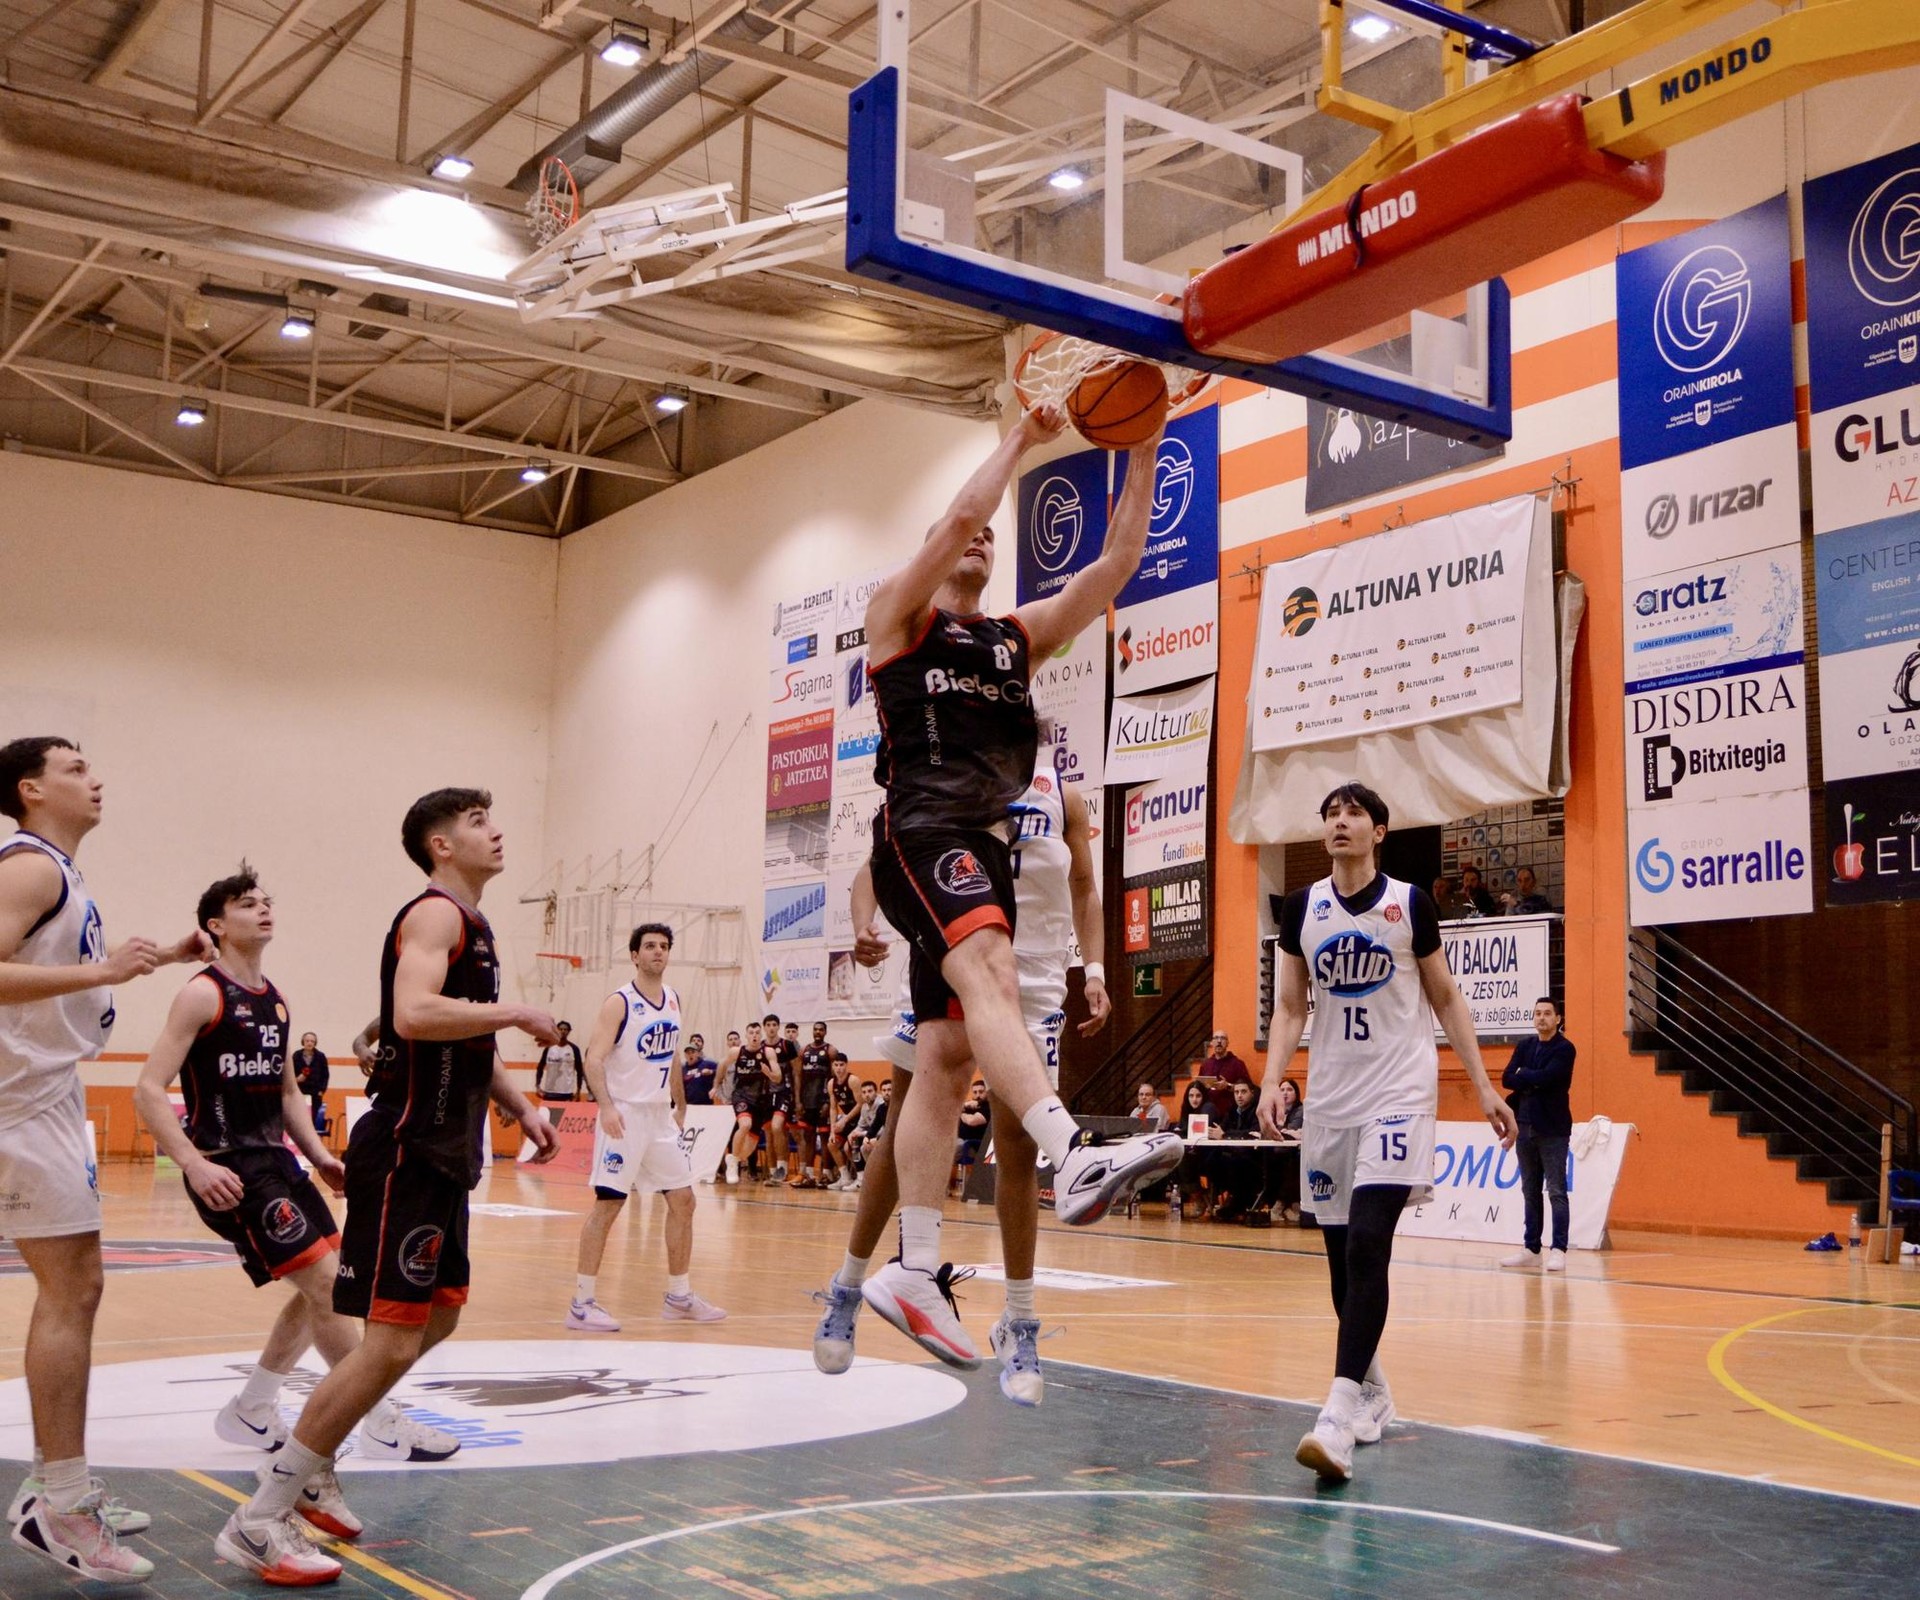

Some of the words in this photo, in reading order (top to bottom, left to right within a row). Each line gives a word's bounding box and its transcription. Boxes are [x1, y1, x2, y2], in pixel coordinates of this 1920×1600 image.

[1660, 36, 1772, 105] MONDO
[1663, 368, 1742, 403] ORAINKIROLA
[1141, 536, 1187, 557] RAINKIROLA
[1327, 572, 1421, 619] ALTUNA
[1427, 565, 1442, 592] Y
[1446, 550, 1504, 588] URIA
[1872, 576, 1910, 591] ENGLISH
[1635, 574, 1727, 616] aratz
[1477, 620, 1496, 631] ALTUNA
[1501, 615, 1516, 624] URIA
[842, 631, 858, 648] 943
[1136, 621, 1214, 663] sidenor
[1407, 637, 1429, 647] ALTUNA
[1433, 632, 1446, 641] URIA
[993, 644, 1012, 671] 8
[1341, 651, 1361, 661] ALTUNA
[1366, 648, 1378, 656] URIA
[1441, 650, 1461, 660] ALTUNA
[1466, 646, 1480, 654] URIA
[1275, 665, 1295, 674] ALTUNA
[1300, 662, 1313, 670] URIA
[1373, 666, 1393, 675] ALTUNA
[1399, 661, 1411, 669] URIA
[1474, 665, 1495, 674] ALTUNA
[1500, 660, 1513, 668] URIA
[773, 670, 832, 703] Sagarna
[1307, 679, 1327, 689] ALTUNA
[1332, 676, 1344, 684] URIA
[1406, 679, 1428, 689] ALTUNA
[1432, 675, 1445, 683] URIA
[1338, 693, 1360, 703] ALTUNA
[1364, 689, 1378, 698] URIA
[1439, 694, 1460, 703] ALTUNA
[1465, 689, 1477, 698] URIA
[1633, 674, 1796, 734] DISDIRA
[1272, 706, 1293, 714] ALTUNA
[1298, 702, 1310, 710] URIA
[1373, 707, 1394, 717] ALTUNA
[1398, 704, 1411, 712] URIA
[1115, 708, 1208, 746] Kulturaz
[1305, 720, 1325, 729] ALTUNA
[1330, 717, 1343, 725] URIA
[772, 743, 829, 770] PASTORKUA
[1053, 747, 1077, 773] Go
[1689, 738, 1786, 775] Bitxitegia
[784, 765, 828, 787] JATETXEA
[1127, 784, 1205, 834] aranur
[1163, 841, 1204, 862] fundibide
[1681, 838, 1724, 851] GRUPO
[1681, 840, 1804, 889] sarralle
[1163, 880, 1200, 907] MILAR
[1152, 903, 1201, 927] LARRAMENDI
[1337, 936, 1355, 953] LA
[1463, 936, 1518, 975] BALOIA
[1317, 951, 1392, 989] SALUD
[1472, 980, 1518, 1000] ZESTOA
[1344, 1007, 1370, 1041] 15
[259, 1024, 280, 1048] 25
[1046, 1037, 1058, 1066] 2
[660, 1067, 669, 1089] 7
[1380, 1133, 1407, 1161] 15
